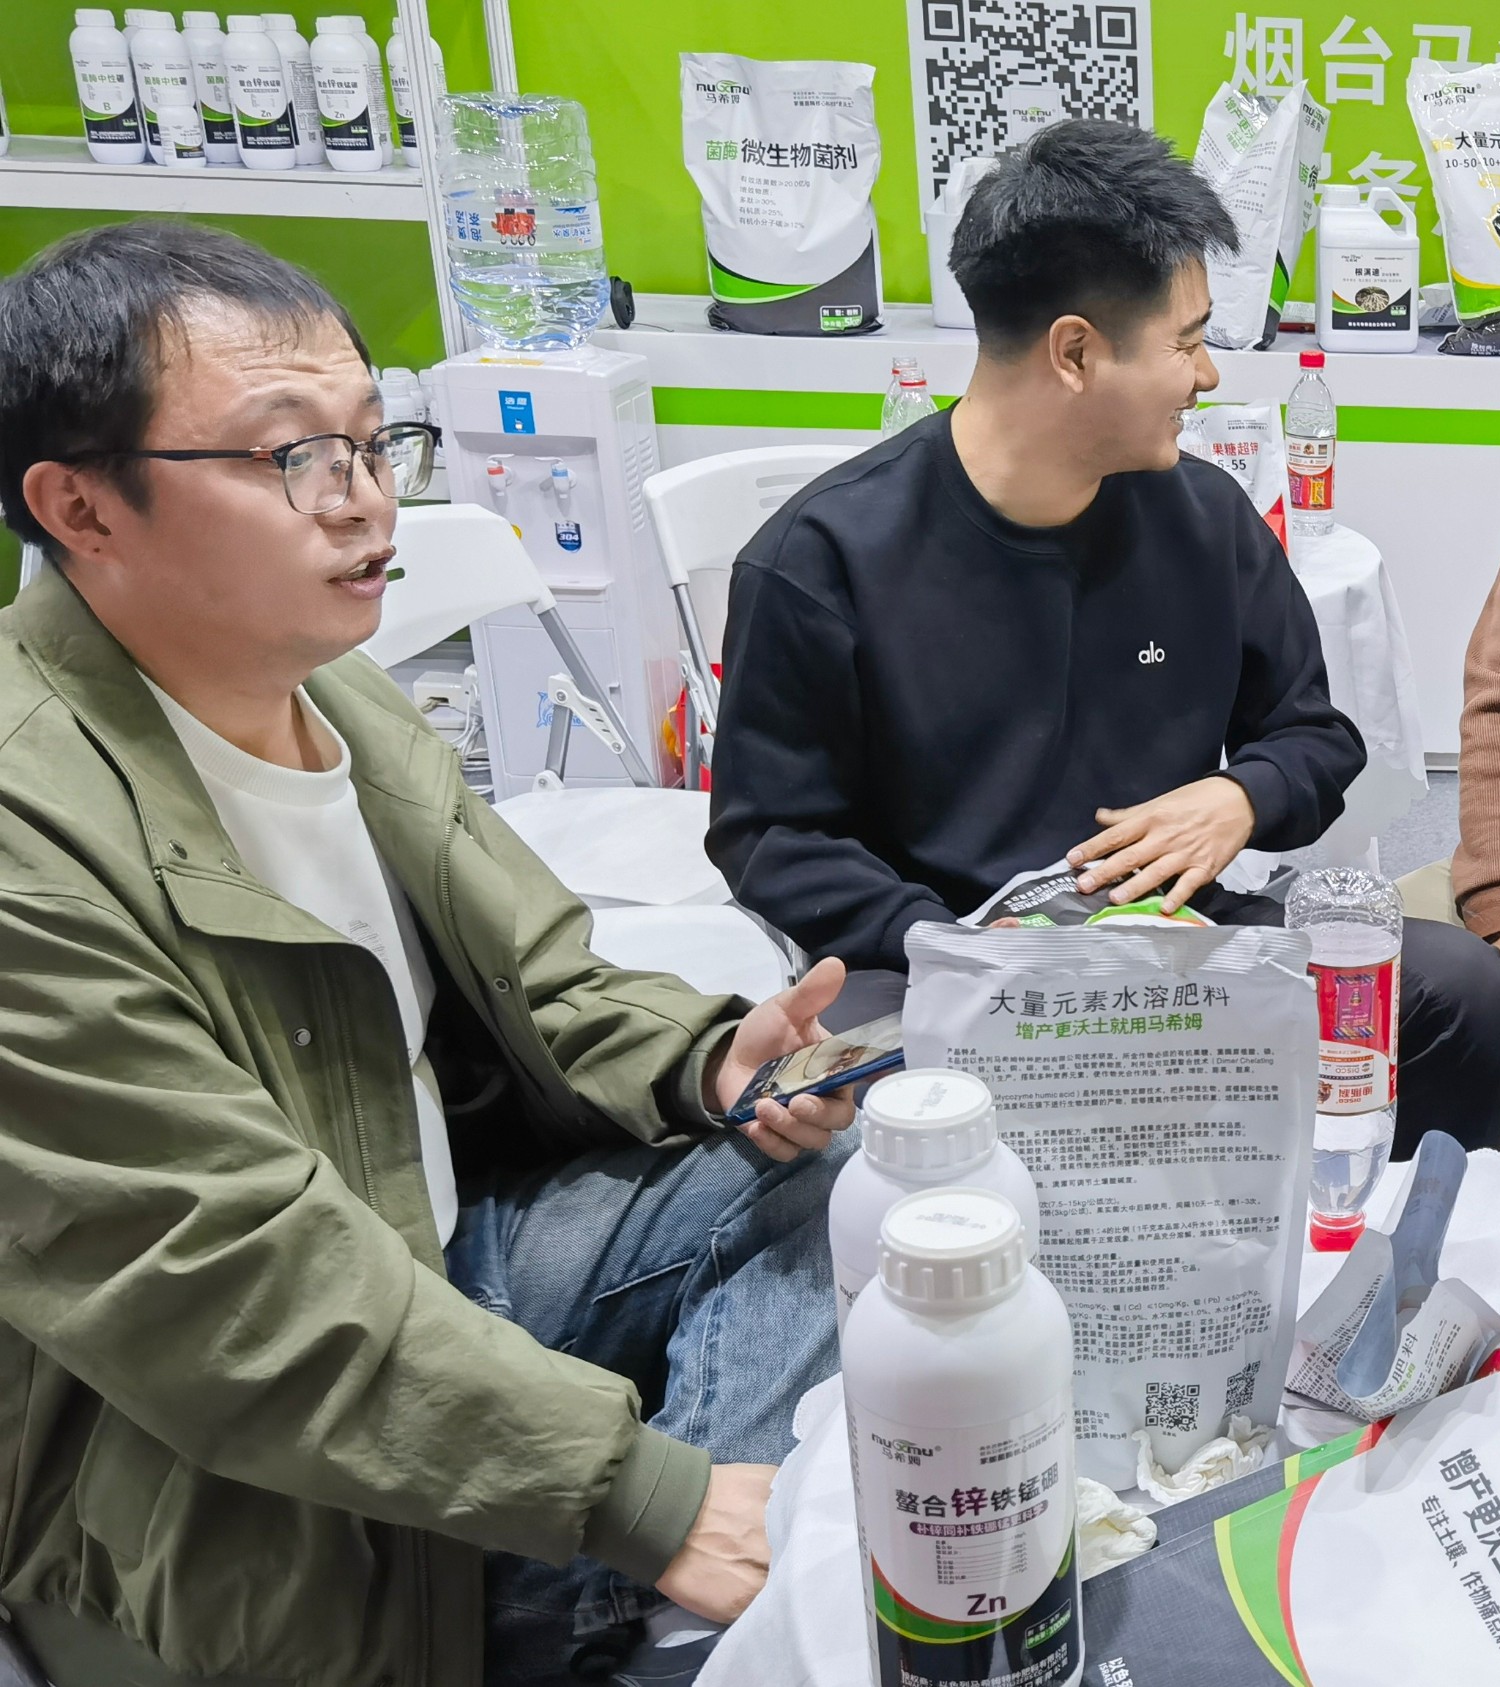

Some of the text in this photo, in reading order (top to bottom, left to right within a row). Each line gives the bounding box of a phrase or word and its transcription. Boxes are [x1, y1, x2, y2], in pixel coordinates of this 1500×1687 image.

[706, 93, 741, 104] 马希姆
[261, 110, 272, 118] Zn
[334, 111, 345, 119] Zn
[706, 138, 858, 170] 菌酶 微生物菌剂
[558, 533, 580, 542] 304
[1138, 641, 1166, 665] alo
[988, 982, 1231, 1018] 大量元素水溶肥料
[1015, 1012, 1204, 1041] 增产更沃土就用马希姆
[881, 1448, 921, 1467] 马希姆
[895, 1461, 1059, 1518] 螯合锌铁锰硼
[966, 1593, 1007, 1617] Zn
